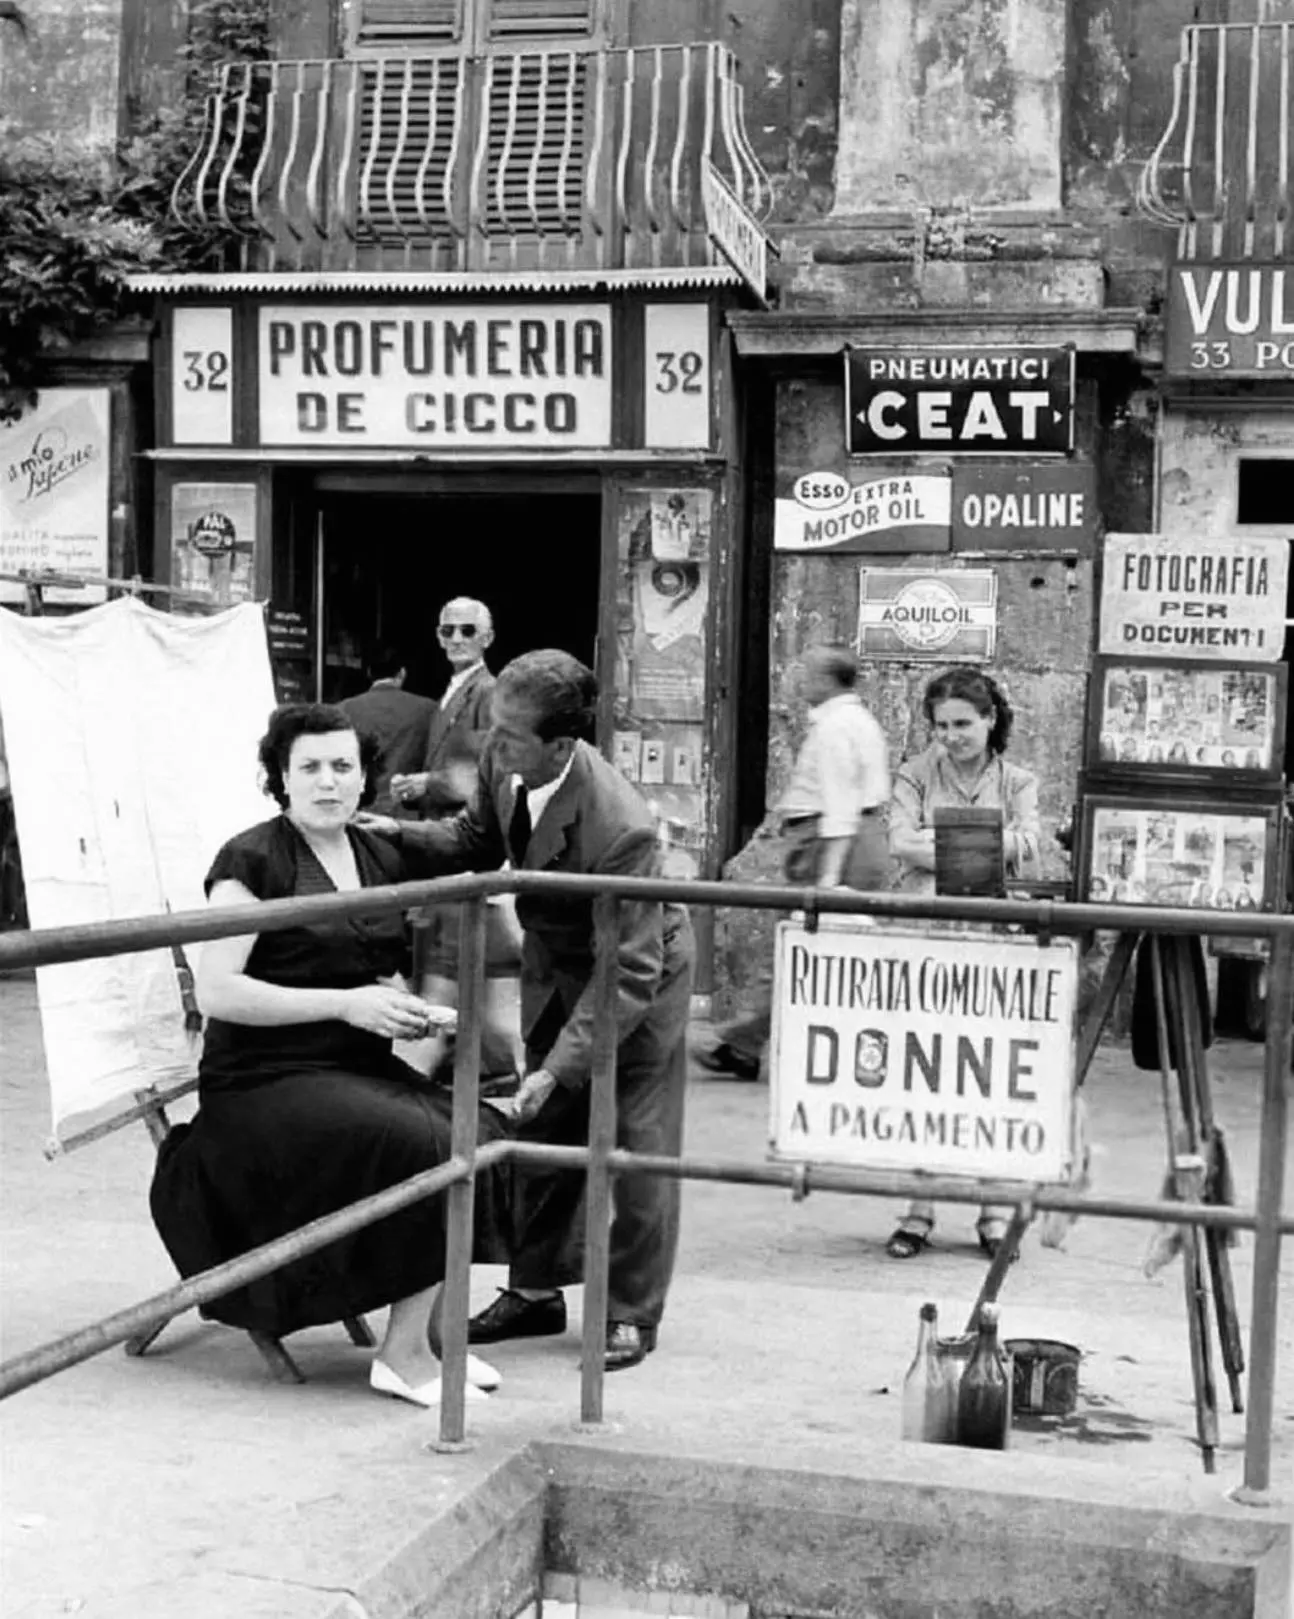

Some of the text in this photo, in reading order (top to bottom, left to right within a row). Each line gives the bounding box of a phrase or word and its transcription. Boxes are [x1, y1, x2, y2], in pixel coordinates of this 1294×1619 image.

[269, 318, 605, 378] PROFUMERIA
[1191, 342, 1231, 368] 33
[183, 351, 229, 392] 32
[654, 351, 703, 394] 32
[870, 358, 1049, 380] PNEUMATICI
[297, 392, 577, 433] DE CICCO
[867, 391, 1050, 440] CEAT
[801, 480, 845, 499] Esso
[854, 480, 914, 505] EXTRA
[803, 498, 925, 543] MOTOR OIL
[963, 494, 1084, 527] OPALINE
[1123, 552, 1268, 596] FOTOGRAFIA
[882, 606, 974, 624] AQUILOIL
[1160, 601, 1228, 619] PER
[1123, 623, 1265, 647] DOCUMENTI
[790, 944, 1062, 1023] RITIRATA COMUNALE
[806, 1024, 1040, 1101] DONNE
[791, 1100, 1045, 1155] A PAGAMENTO
